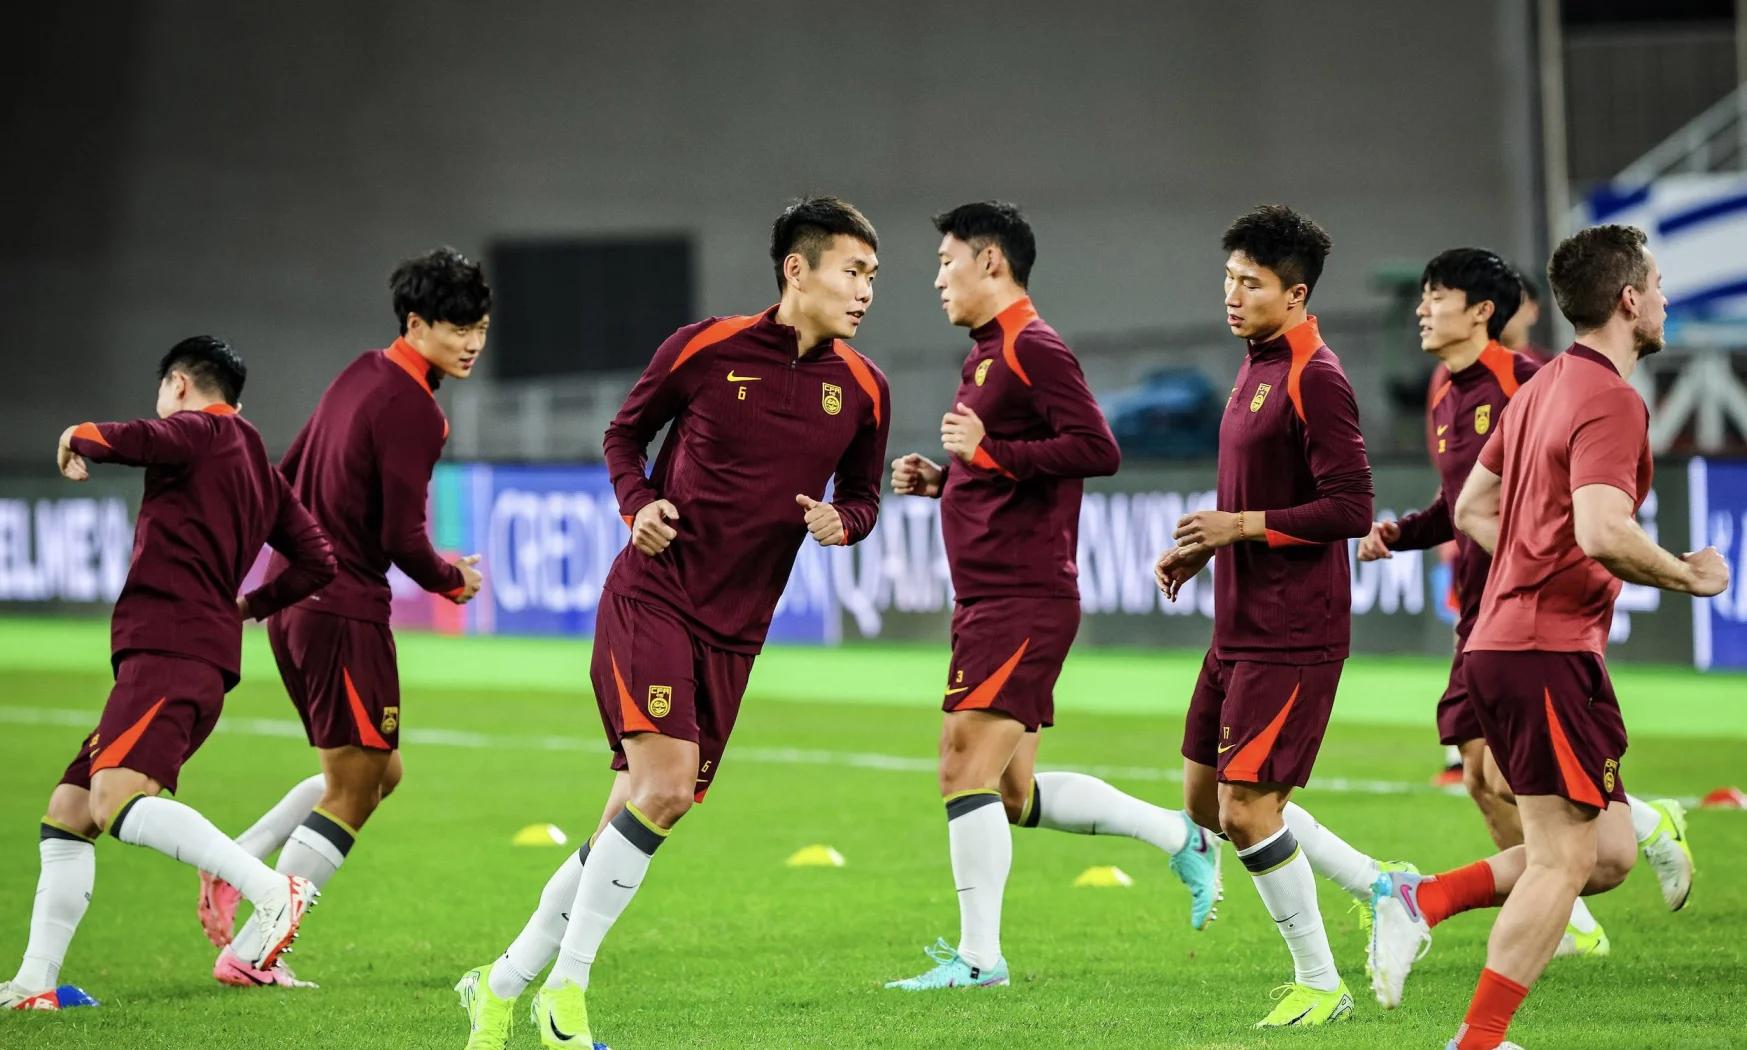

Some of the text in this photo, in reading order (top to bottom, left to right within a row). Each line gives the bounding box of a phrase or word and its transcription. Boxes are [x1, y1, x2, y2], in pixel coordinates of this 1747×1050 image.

[738, 386, 747, 400] 6
[955, 668, 964, 683] 3
[1223, 726, 1231, 740] 17
[700, 760, 712, 773] 6
